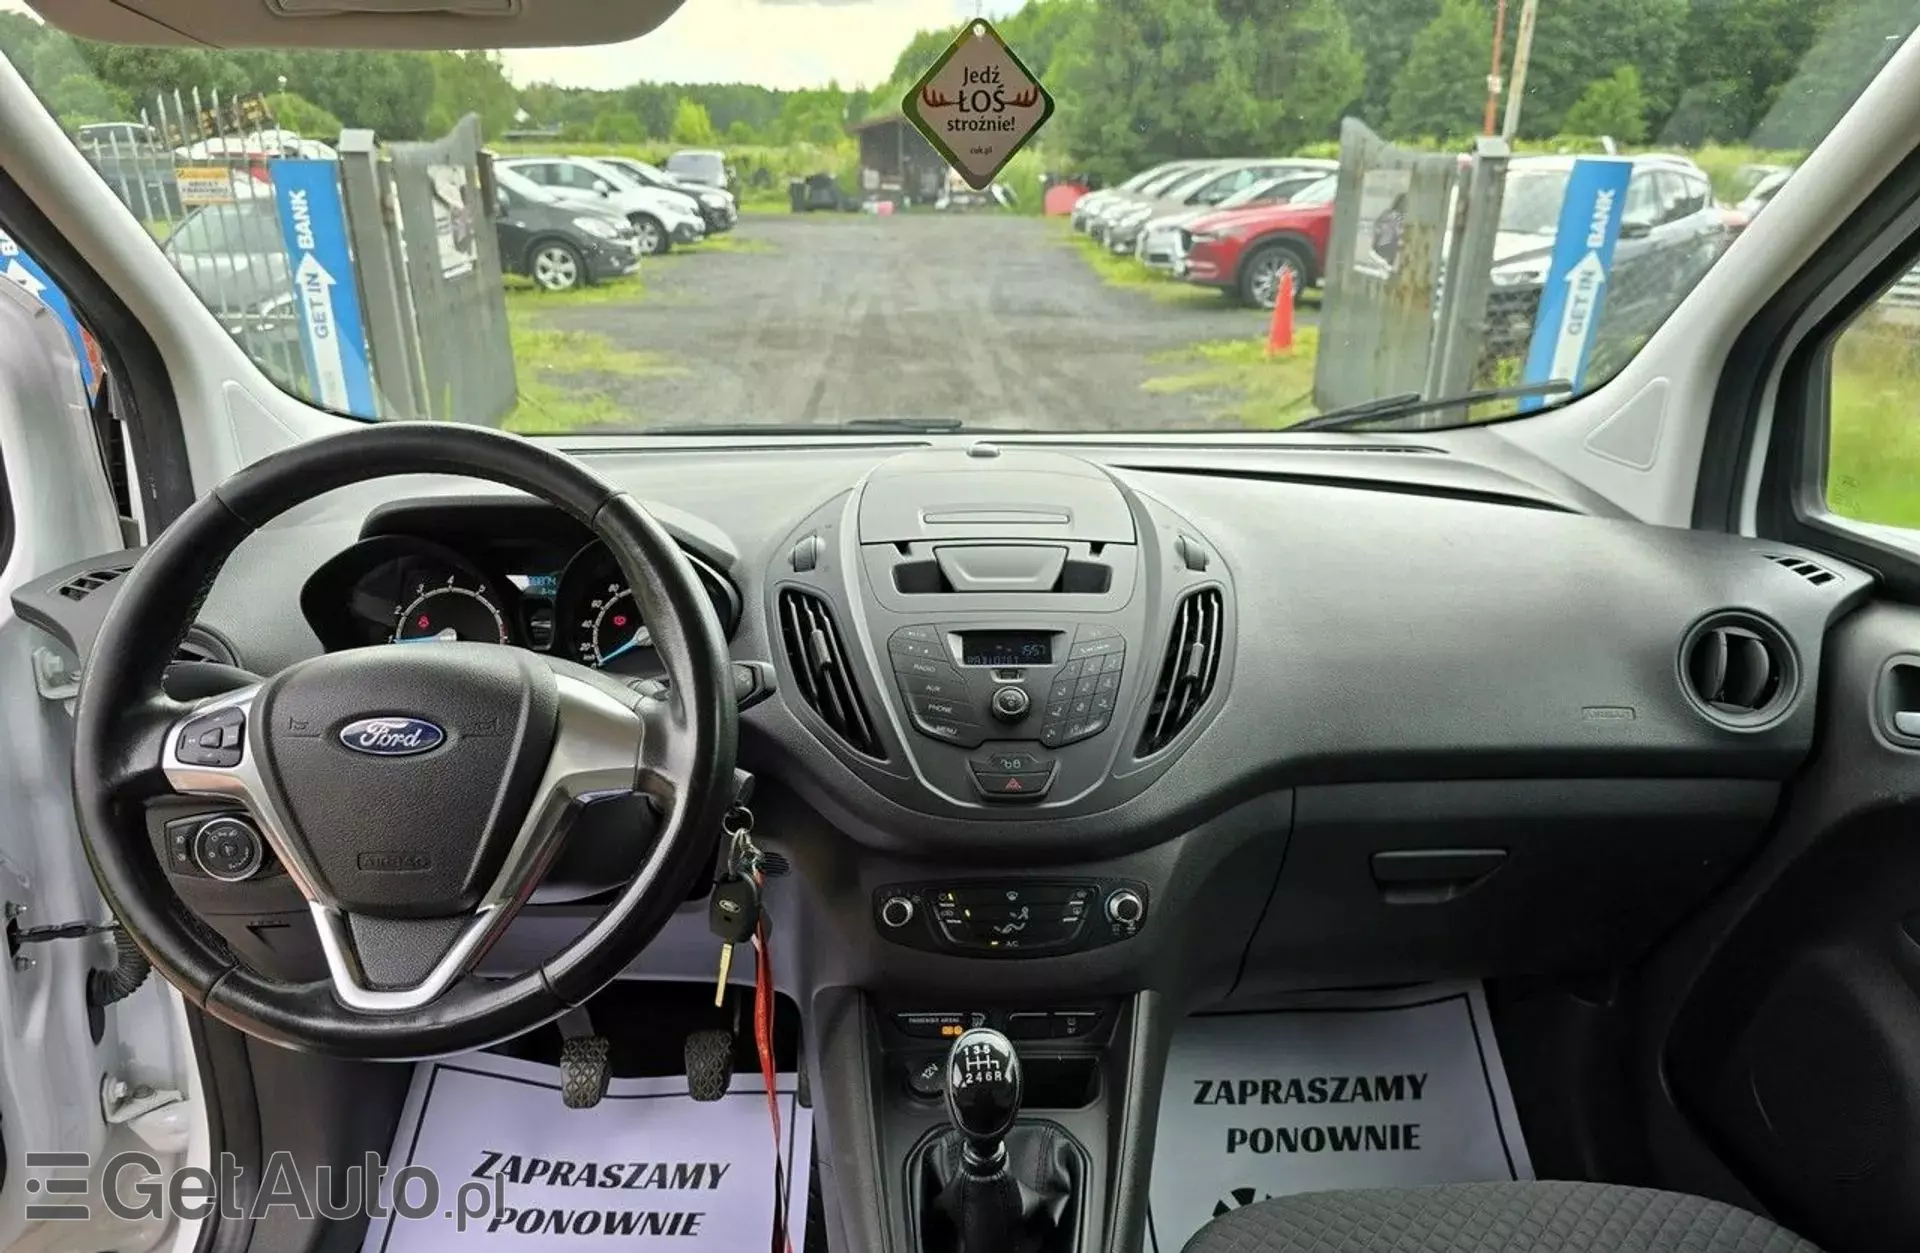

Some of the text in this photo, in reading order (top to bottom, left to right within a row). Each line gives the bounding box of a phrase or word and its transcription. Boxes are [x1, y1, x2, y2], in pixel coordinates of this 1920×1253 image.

[962, 65, 1000, 87] Jedź
[958, 84, 1006, 113] ŁOŚ
[288, 188, 330, 339] GET IN BANK
[1567, 188, 1616, 336] GET IN BANK
[360, 721, 423, 747] Ford
[964, 1045, 991, 1056] 1 3 5
[921, 1063, 939, 1079] 12V
[965, 1070, 1002, 1084] 2 4 6 R
[1193, 1072, 1428, 1106] ZAPRASZAMY
[1226, 1123, 1422, 1154] PONOWNIE
[471, 1150, 731, 1190] ZAPRASZAMY
[486, 1207, 706, 1236] PONOWNIE
